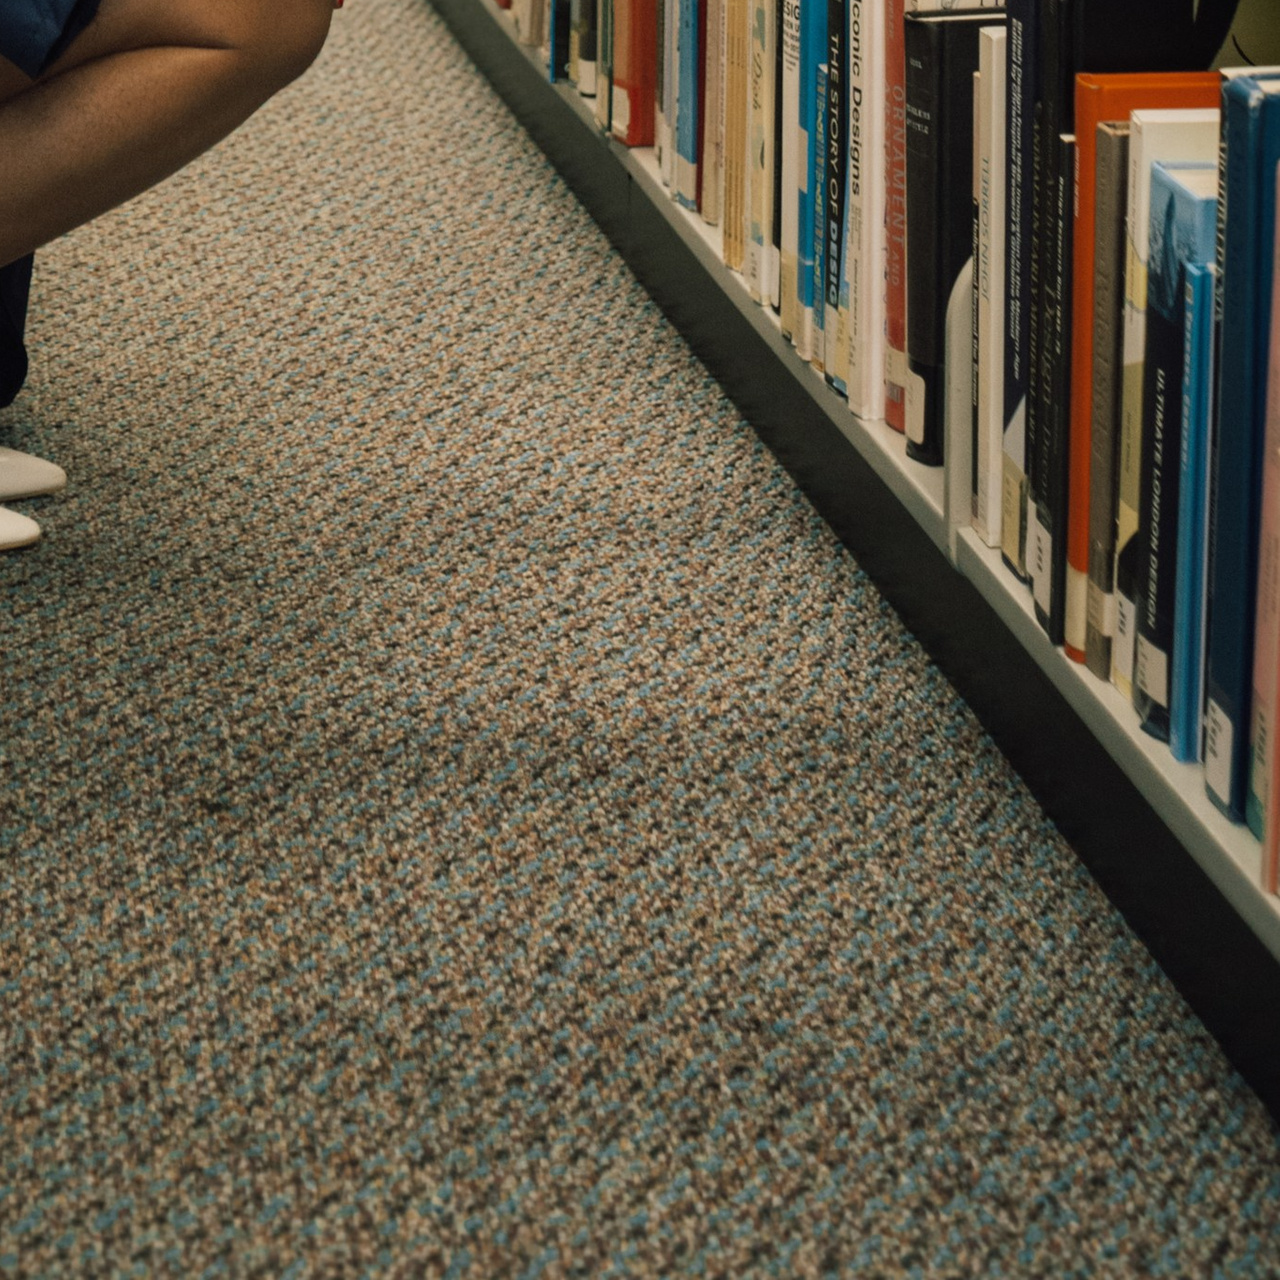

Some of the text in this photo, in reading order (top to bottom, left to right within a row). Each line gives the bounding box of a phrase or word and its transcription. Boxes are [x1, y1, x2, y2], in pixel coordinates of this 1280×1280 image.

[828, 33, 839, 306] THE STORY OF DESIG
[850, 85, 864, 197] Designs
[891, 84, 906, 249] ORNAMENT
[980, 156, 990, 239] SORRELL
[980, 241, 991, 302] JOHN
[1146, 367, 1166, 628] ULTIMATE LONDON DESIGN
